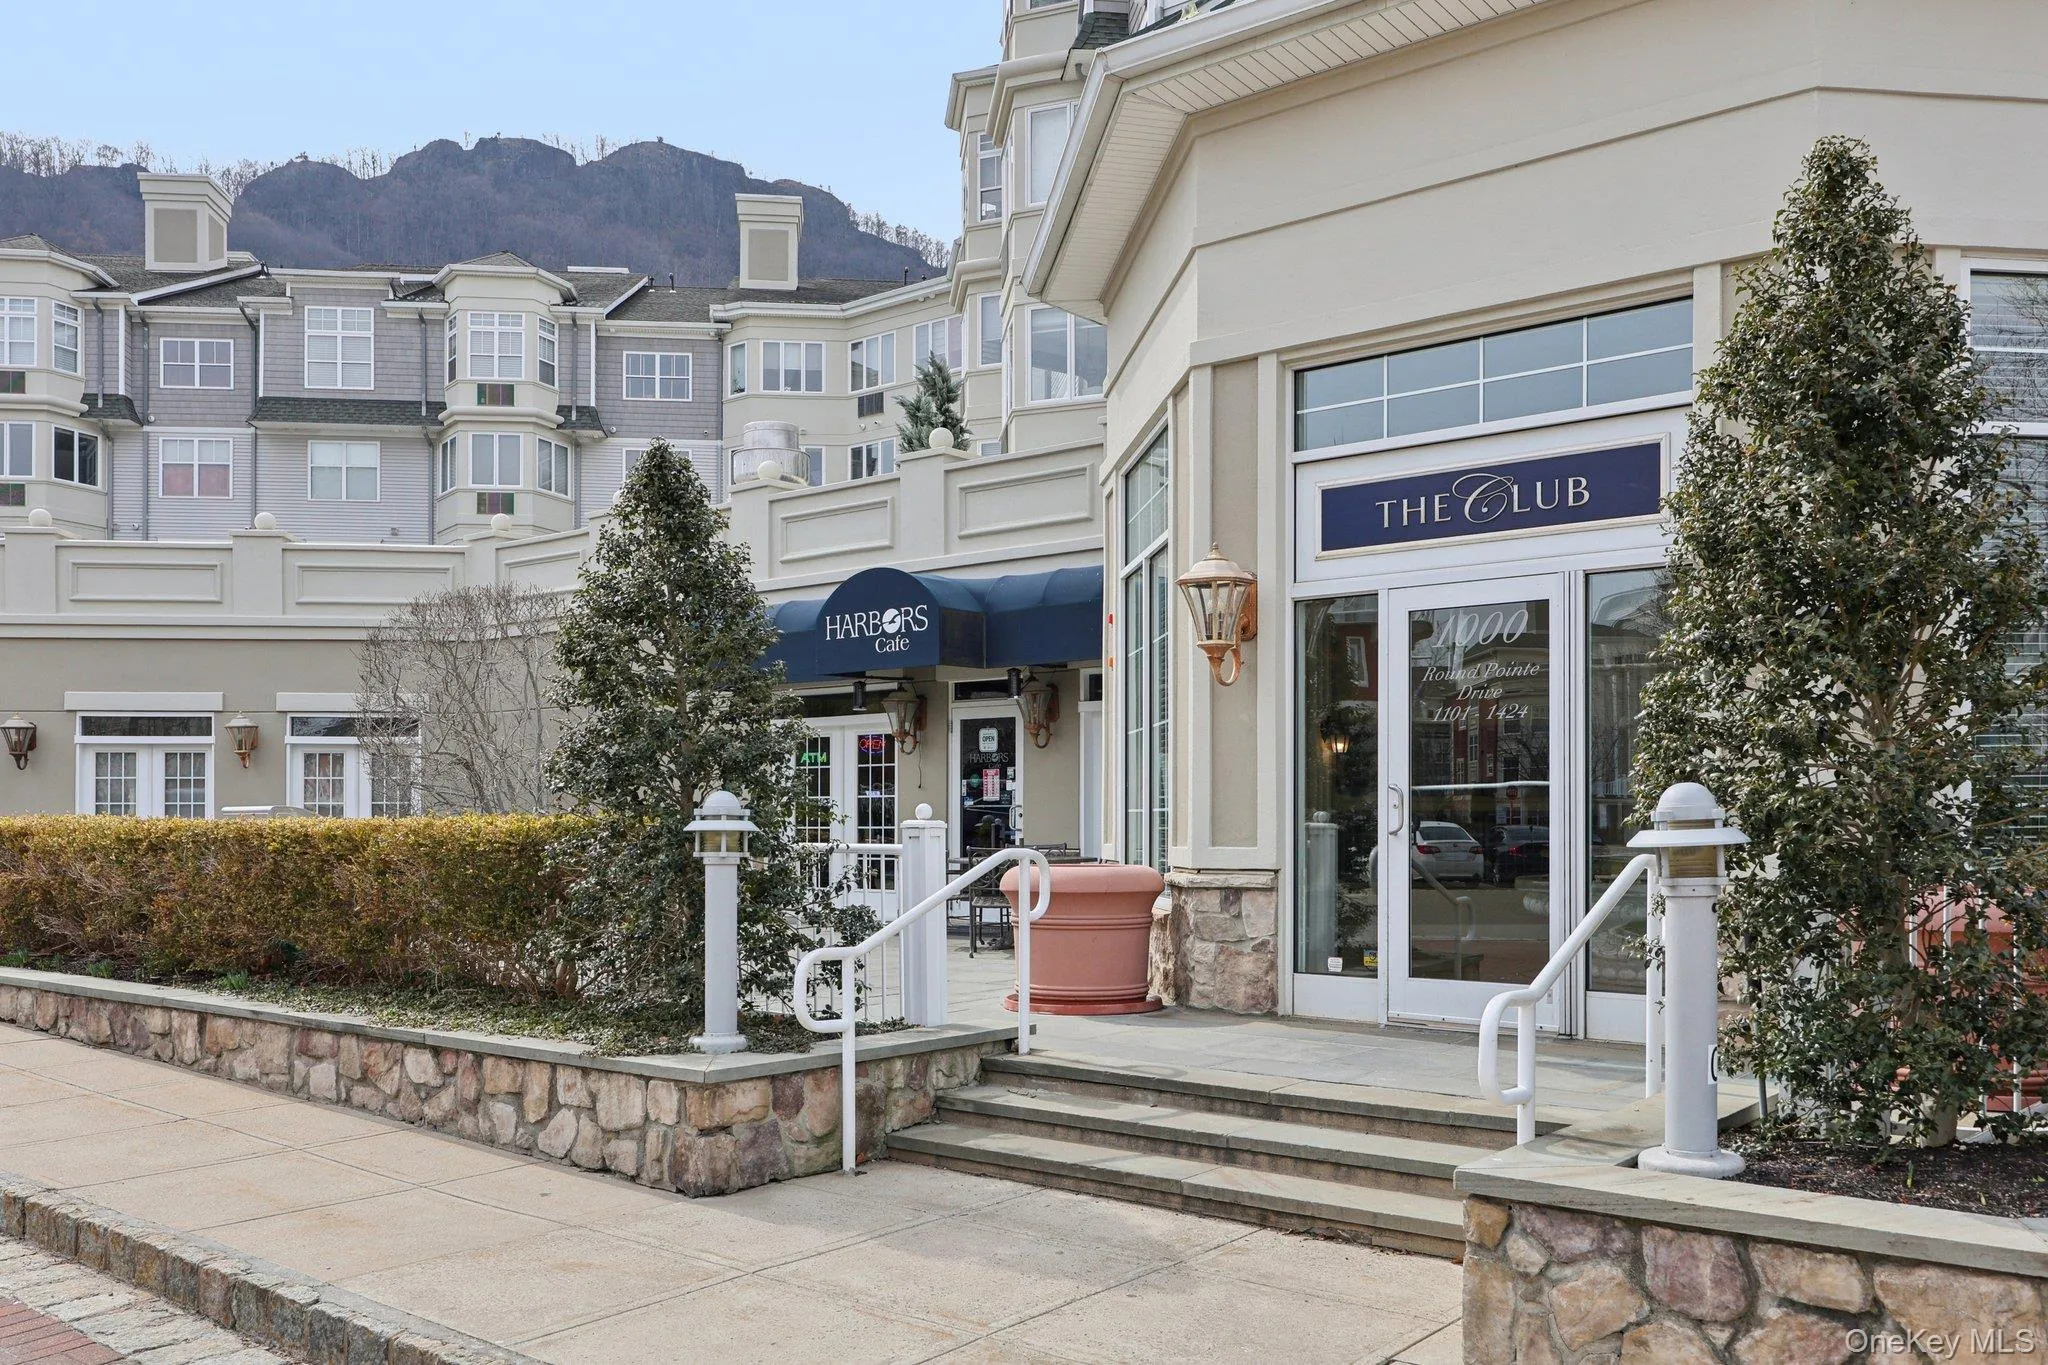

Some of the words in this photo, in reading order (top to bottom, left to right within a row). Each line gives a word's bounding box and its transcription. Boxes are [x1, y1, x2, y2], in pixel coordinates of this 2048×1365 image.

[1376, 494, 1450, 528] THE
[1452, 473, 1590, 523] CLUB
[826, 604, 928, 641] HARBORS
[1432, 609, 1529, 648] 1000
[875, 634, 910, 653] Cafe
[1422, 663, 1481, 682] Round
[1484, 661, 1540, 679] Pointe
[1456, 684, 1503, 701] Drive
[1433, 705, 1472, 722] 1101
[1486, 703, 1529, 720] 1424
[859, 738, 887, 750] OPEN
[982, 735, 995, 743] OPEN
[800, 752, 827, 765] ATM
